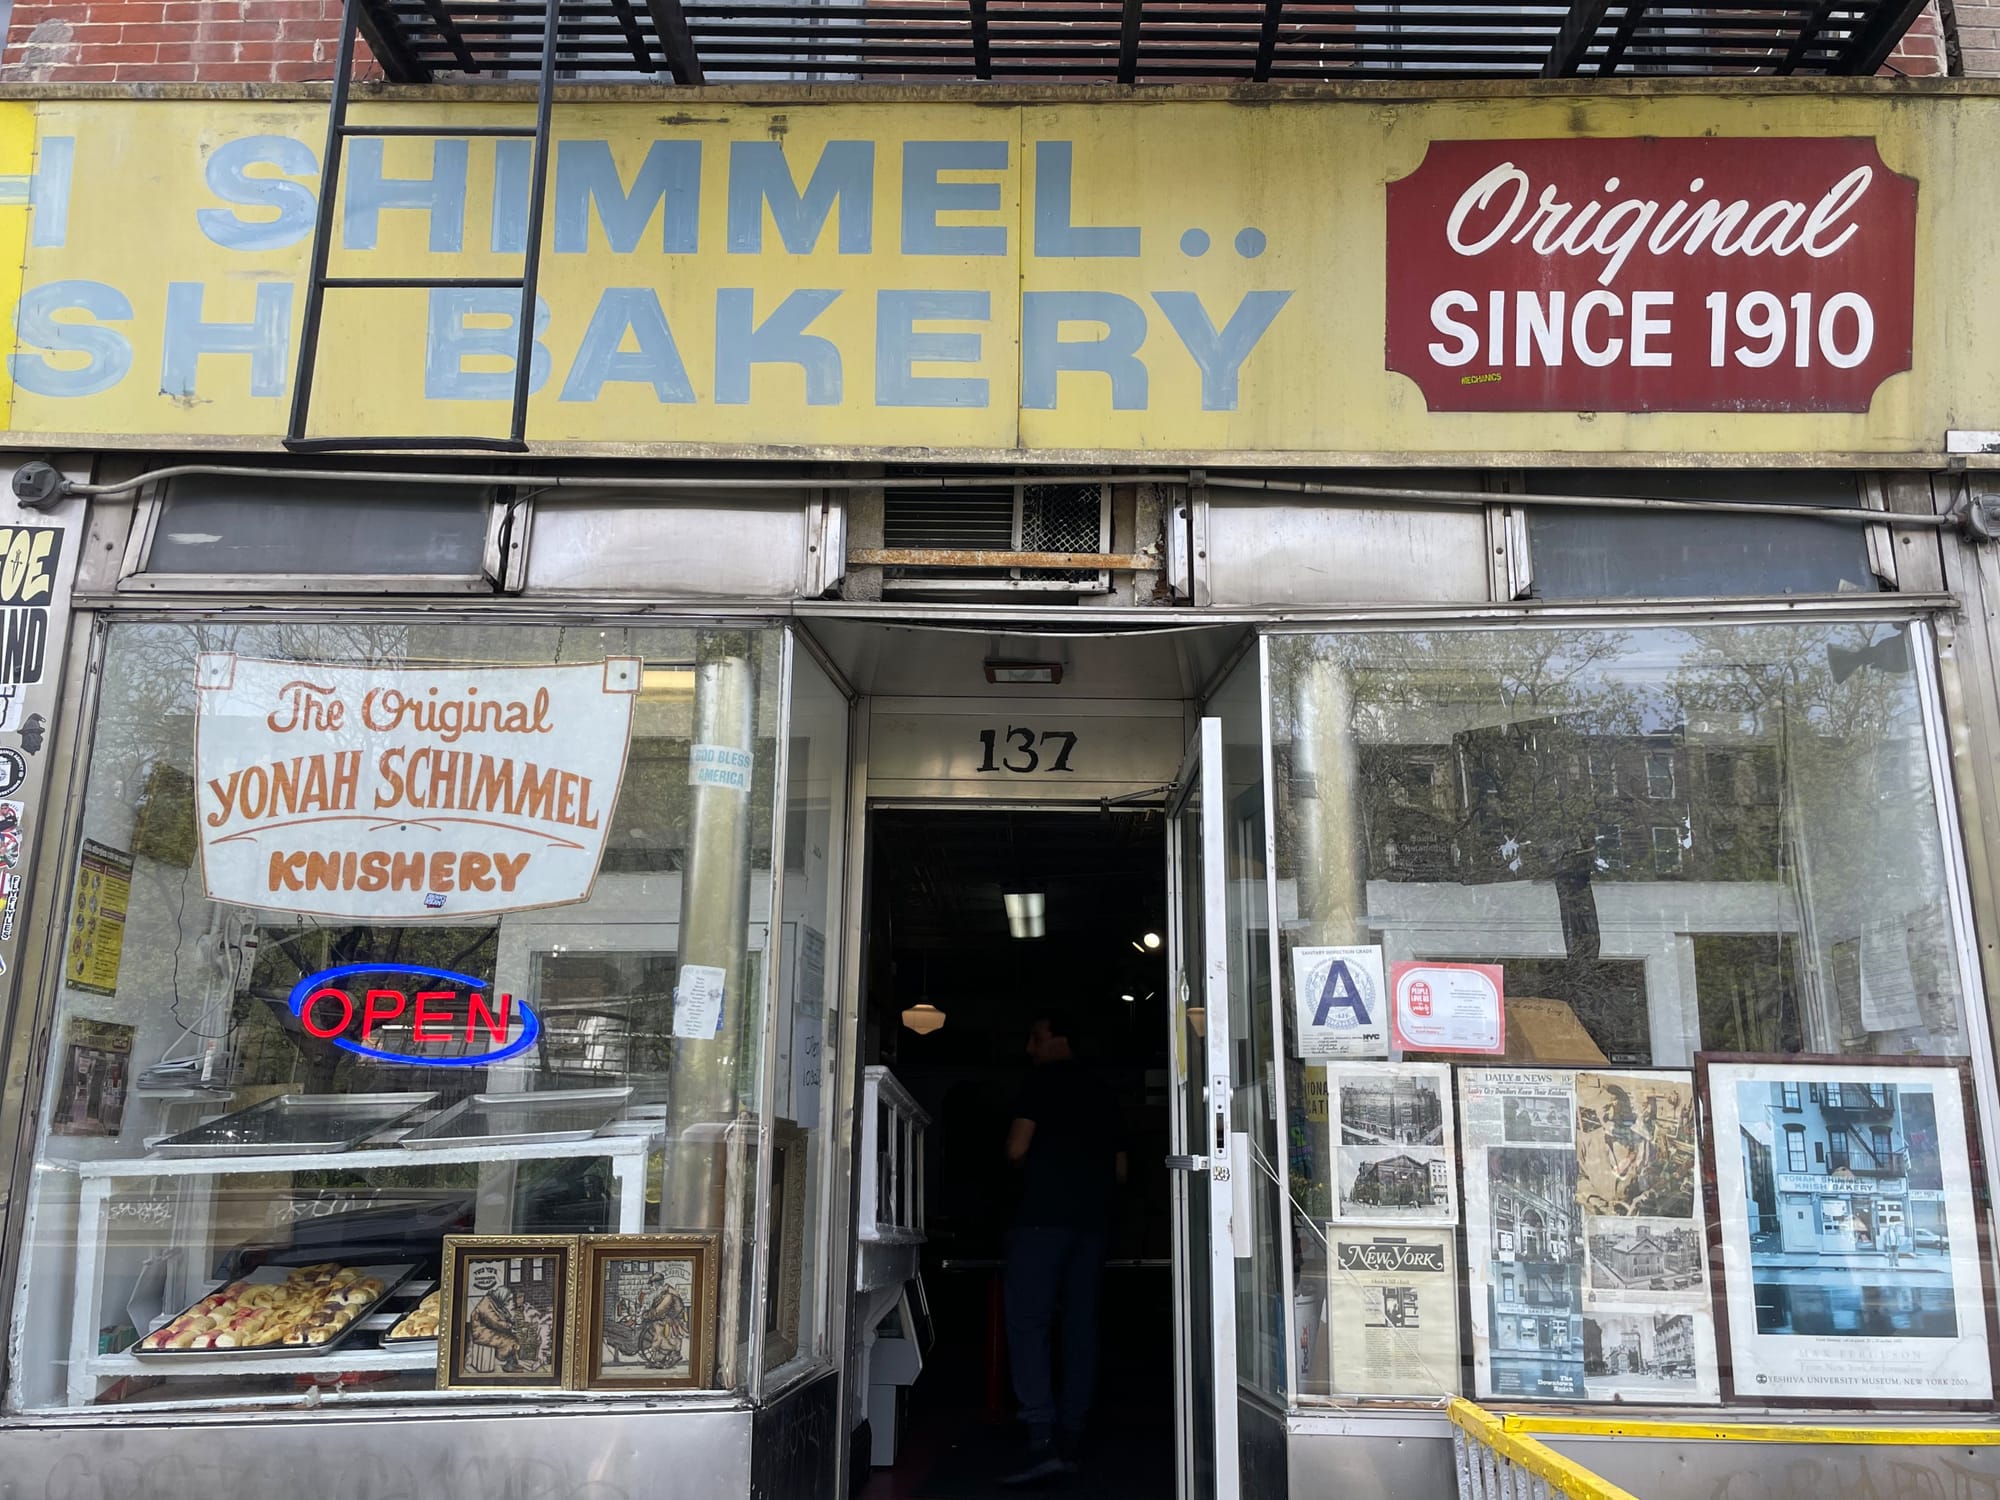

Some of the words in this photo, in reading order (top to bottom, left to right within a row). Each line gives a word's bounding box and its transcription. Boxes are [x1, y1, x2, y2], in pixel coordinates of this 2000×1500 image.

[1446, 162, 1873, 285] Original
[425, 287, 1296, 411] BAKERY
[1428, 289, 1675, 367] SINCE
[1706, 290, 1875, 369] 1910
[267, 680, 345, 733] The
[362, 685, 554, 743] Original
[717, 750, 751, 769] BLESS
[976, 725, 1078, 774] 137
[207, 748, 364, 828] YONAH
[374, 744, 600, 831] SCHIMMEL
[698, 768, 744, 787] AMERICA
[267, 850, 532, 893] KNISHERY
[301, 986, 512, 1045] OPEN
[1312, 959, 1373, 1027] A
[1485, 1073, 1514, 1082] DAILY
[1523, 1074, 1553, 1083] NEWS
[1832, 1183, 1873, 1191] BAKERY
[1537, 1379, 1574, 1387] Downtown
[1768, 1374, 1805, 1384] YESHIVA
[1807, 1375, 1859, 1385] UNIVERSITY
[1904, 1378, 1923, 1386] NEW
[1926, 1378, 1949, 1387] YORK
